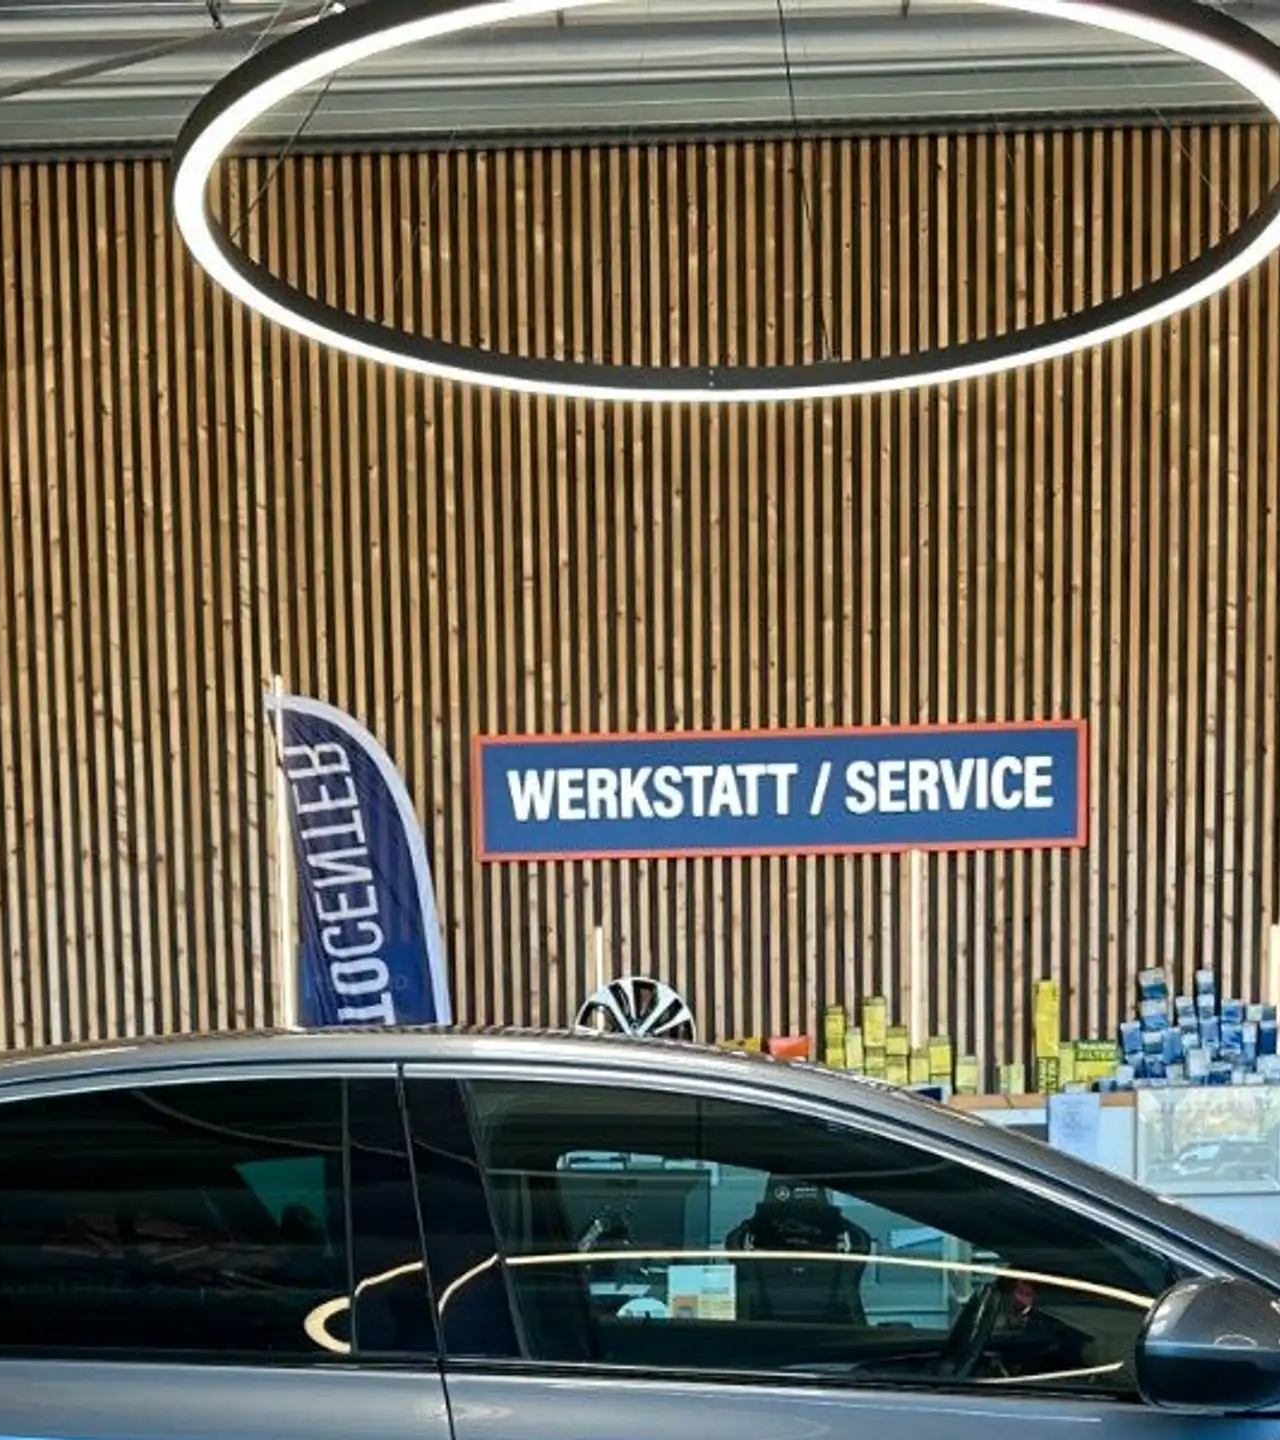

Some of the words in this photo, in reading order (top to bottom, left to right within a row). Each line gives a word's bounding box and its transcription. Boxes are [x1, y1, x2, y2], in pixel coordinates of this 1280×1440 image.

[507, 763, 798, 820] WERKSTATT
[810, 760, 831, 815] /
[845, 755, 1053, 813] SERVICE
